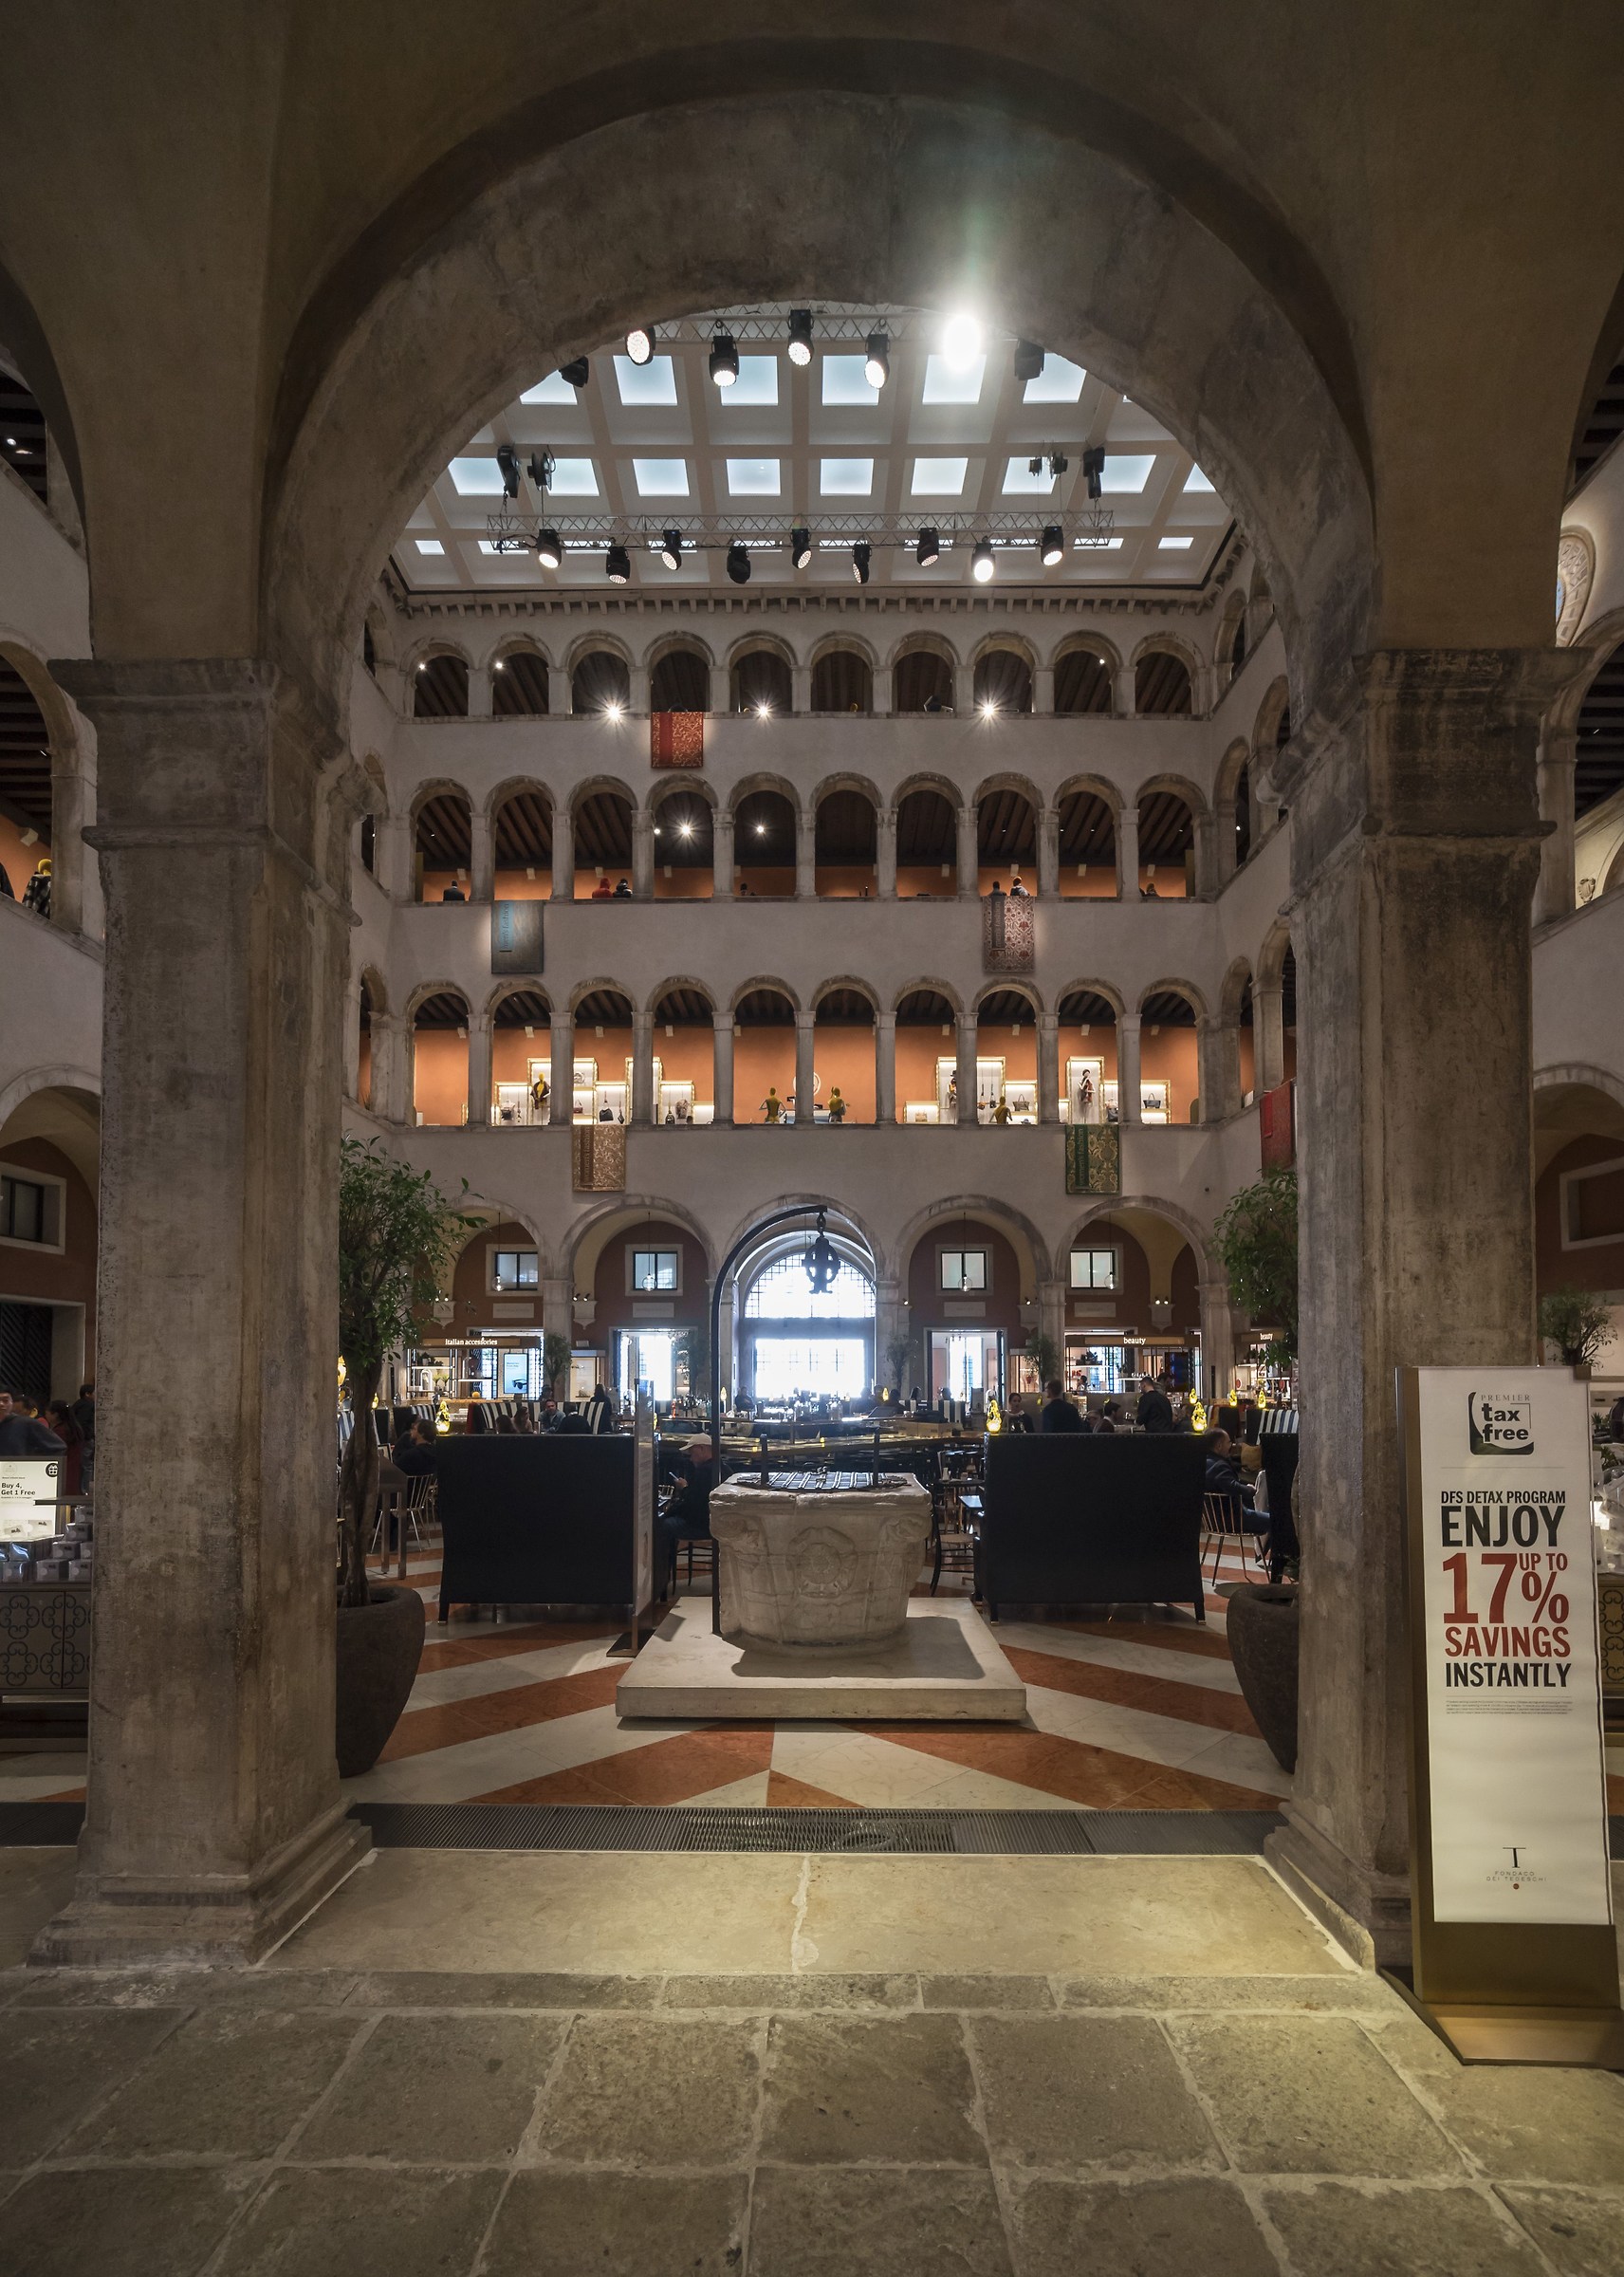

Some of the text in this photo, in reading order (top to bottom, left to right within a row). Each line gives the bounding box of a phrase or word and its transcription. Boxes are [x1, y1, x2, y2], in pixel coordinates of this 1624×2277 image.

[1077, 1128, 1085, 1155] fashion
[1123, 1337, 1146, 1345] beauty
[1260, 1332, 1274, 1342] beauty
[1481, 1402, 1521, 1422] tax
[1482, 1423, 1529, 1443] free
[1441, 1491, 1566, 1504] DFS DETAX PROGRAM
[1441, 1505, 1566, 1547] ENJOY
[1519, 1553, 1568, 1571] UP TO
[1442, 1553, 1570, 1624] 17%
[1445, 1626, 1571, 1658] SAVINGS
[1445, 1662, 1572, 1688] INSTANTLY
